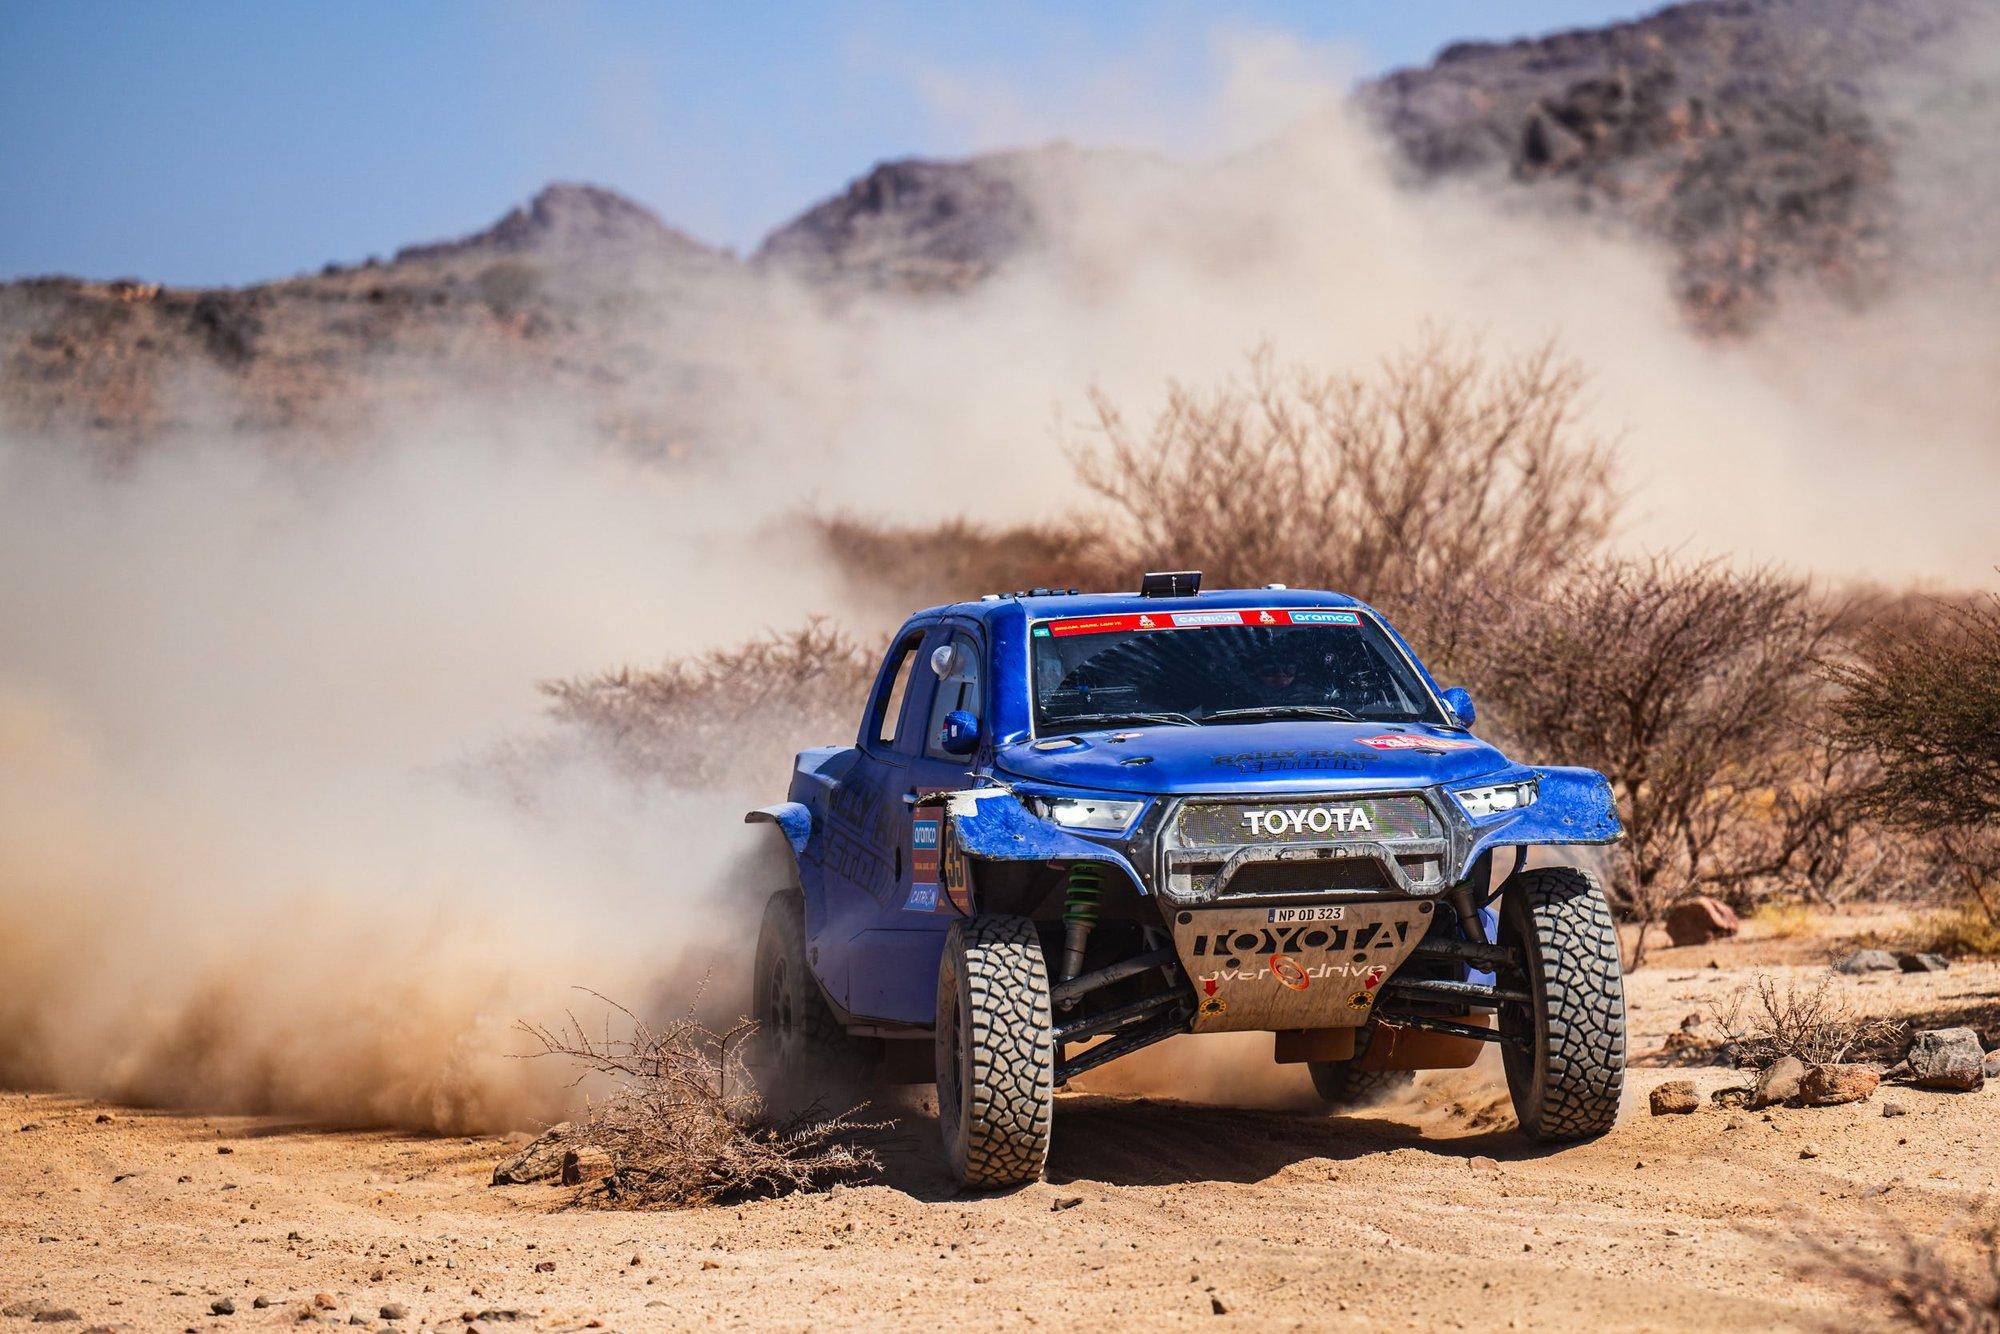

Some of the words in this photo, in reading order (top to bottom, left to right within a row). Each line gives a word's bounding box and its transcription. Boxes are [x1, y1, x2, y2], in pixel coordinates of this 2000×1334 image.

[1293, 613, 1354, 623] aramco
[1243, 807, 1372, 835] TOYOTA
[914, 827, 936, 843] aramco
[1279, 910, 1295, 921] NP
[1298, 909, 1315, 921] OD
[1317, 907, 1341, 920] 323
[1193, 921, 1409, 956] TOYOTA
